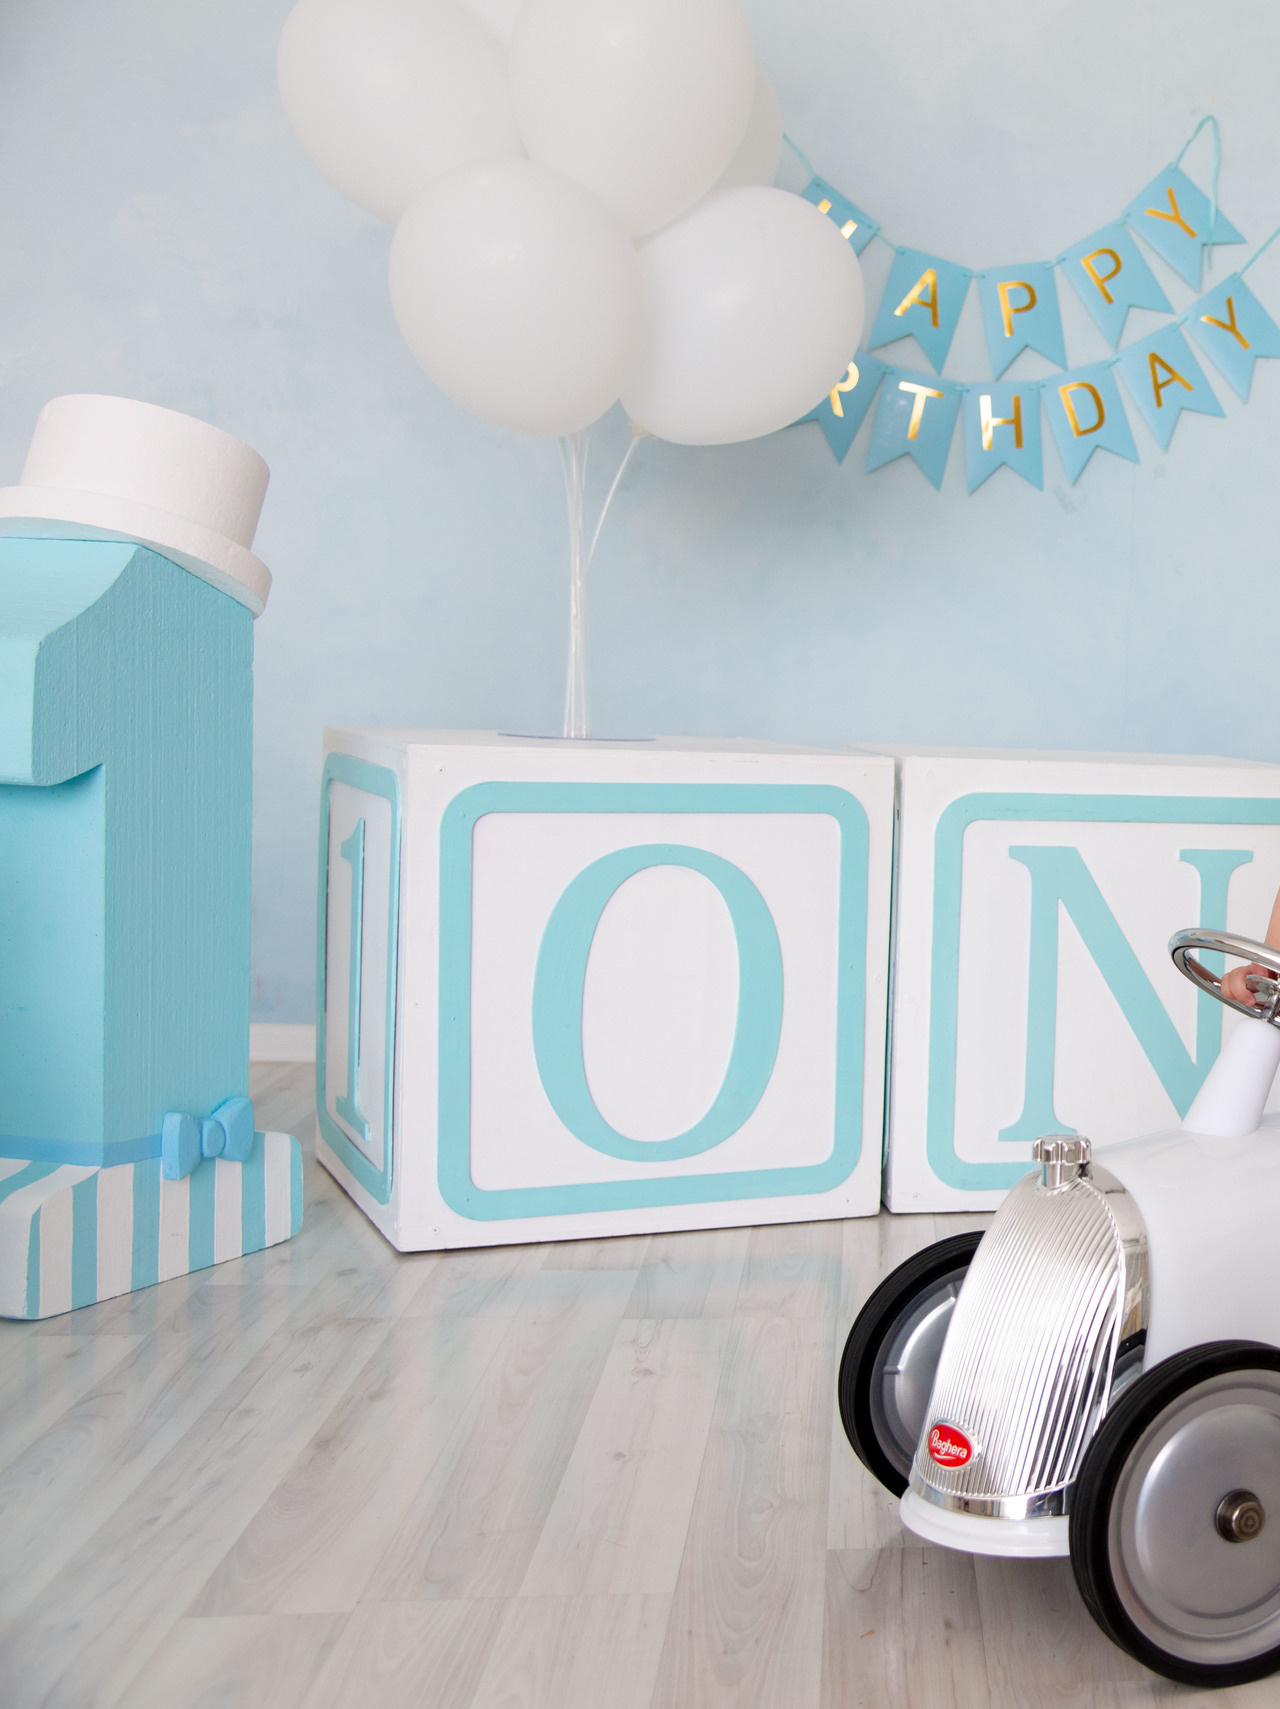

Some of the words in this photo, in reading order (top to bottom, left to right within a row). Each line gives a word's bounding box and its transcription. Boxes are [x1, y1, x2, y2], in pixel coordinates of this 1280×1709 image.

[817, 187, 1197, 338] APPY
[829, 296, 1250, 451] RTHDAY
[932, 1430, 967, 1457] Baghera
